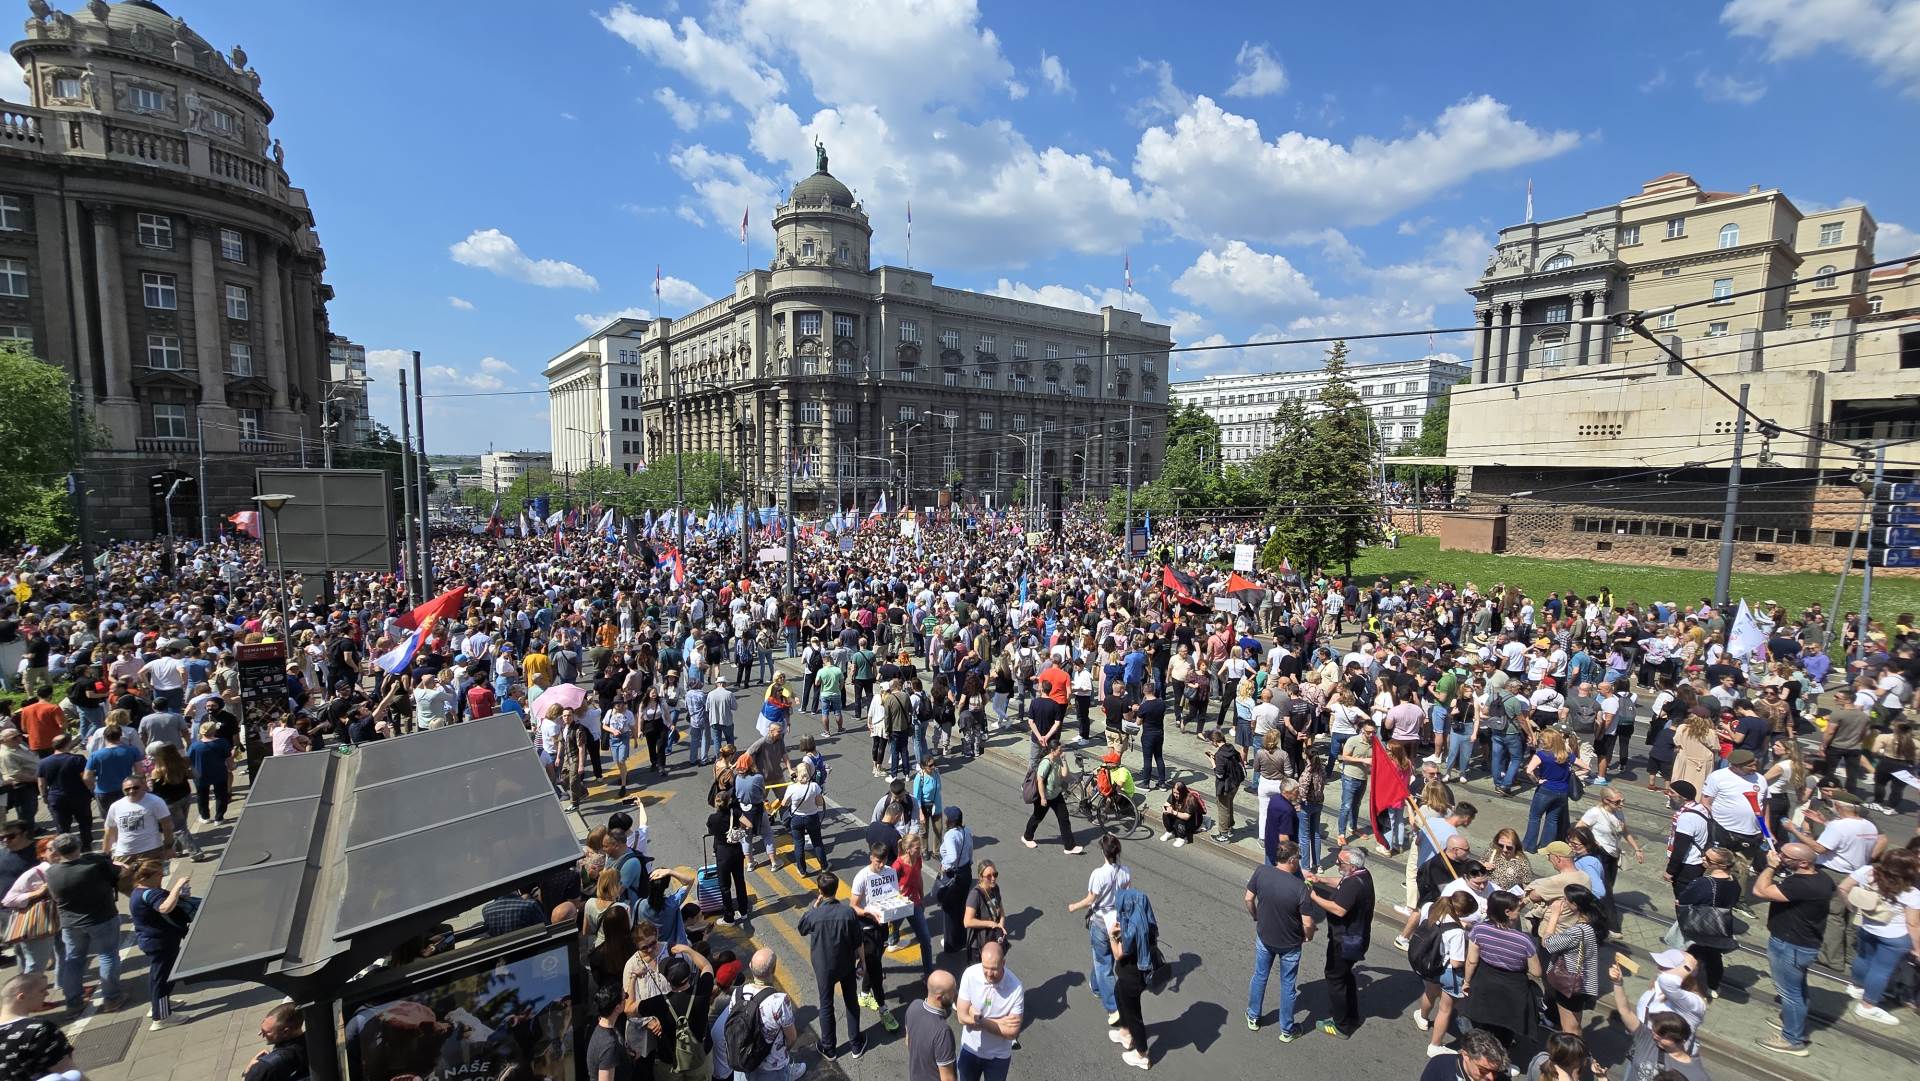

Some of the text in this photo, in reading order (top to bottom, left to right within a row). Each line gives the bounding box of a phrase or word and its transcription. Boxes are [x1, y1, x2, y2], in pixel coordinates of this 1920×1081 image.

[870, 874, 895, 887] BEDŽEVI
[872, 887, 883, 897] 200
[444, 1059, 491, 1079] NAŠE
